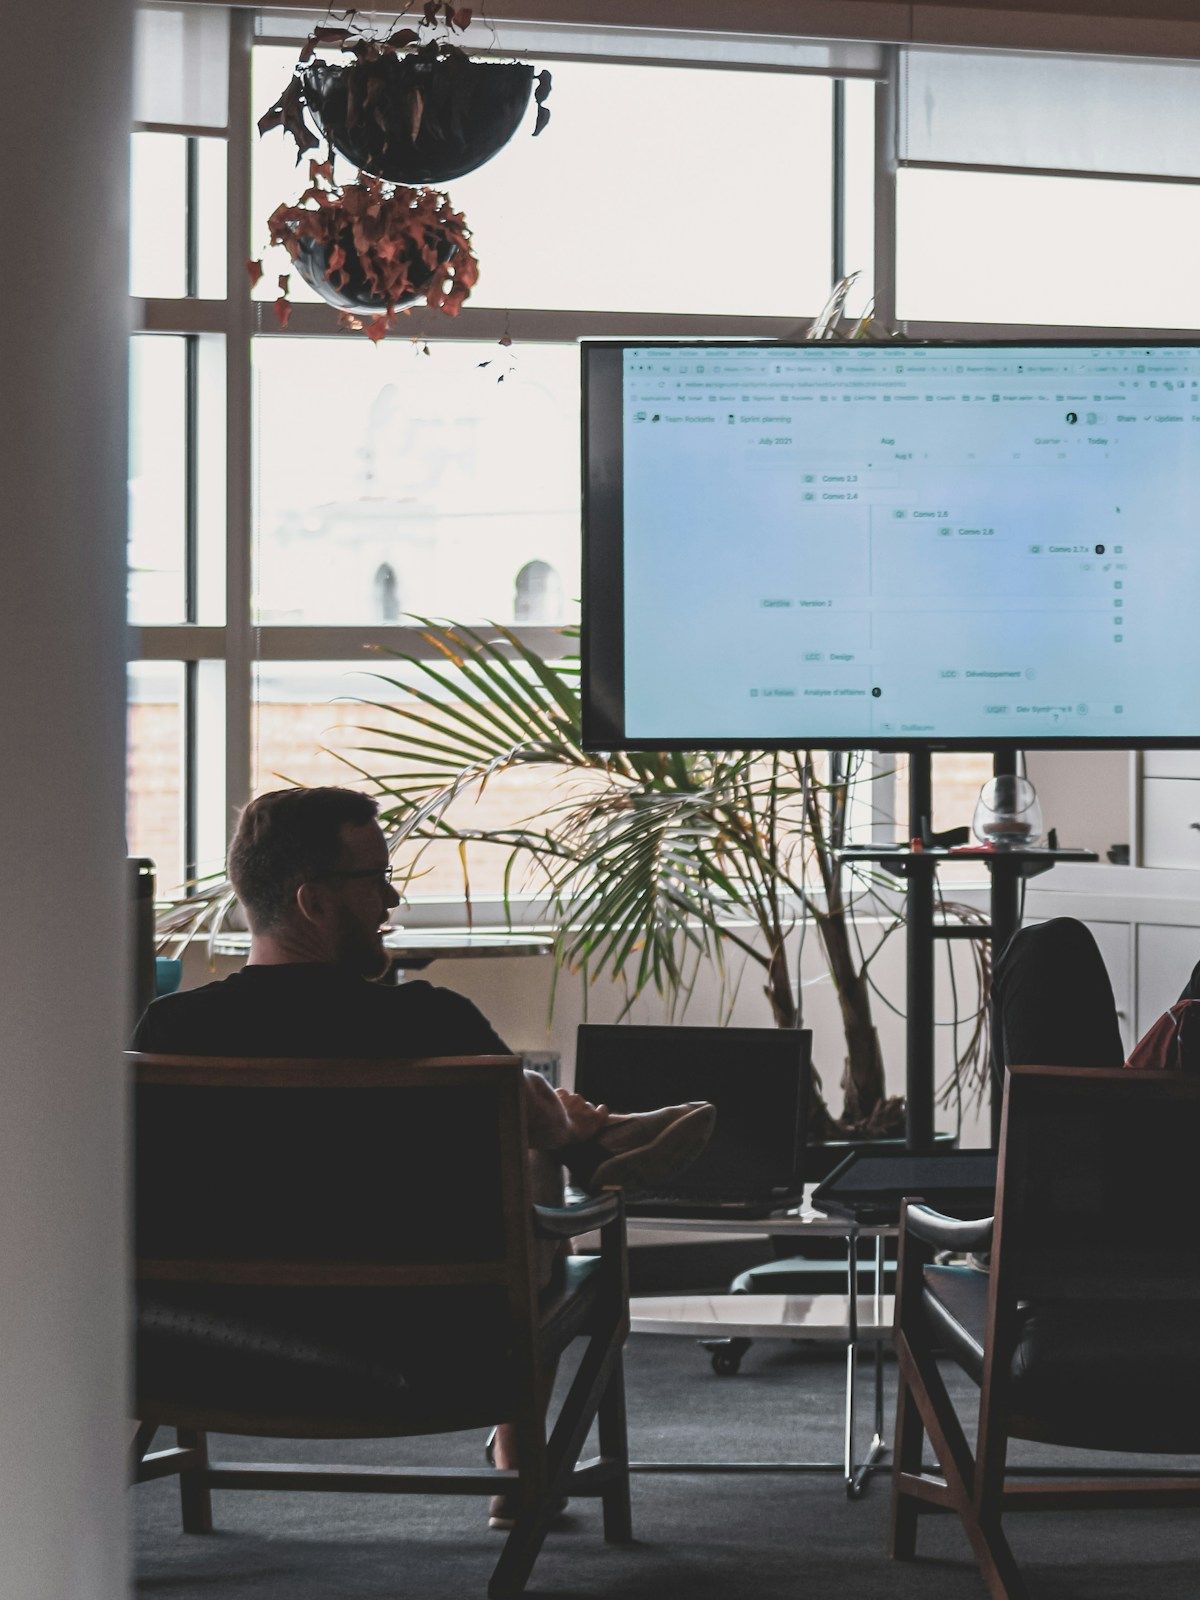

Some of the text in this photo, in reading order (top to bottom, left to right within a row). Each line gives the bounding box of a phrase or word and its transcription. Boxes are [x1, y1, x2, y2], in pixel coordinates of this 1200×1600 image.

[740, 416, 792, 425] Sprint planning
[1155, 415, 1184, 424] Updates
[758, 437, 773, 446] July
[881, 437, 896, 446] Aug
[1088, 437, 1108, 447] Today
[830, 653, 854, 662] Design
[965, 670, 1021, 679] Développement
[804, 689, 831, 697] Analyse
